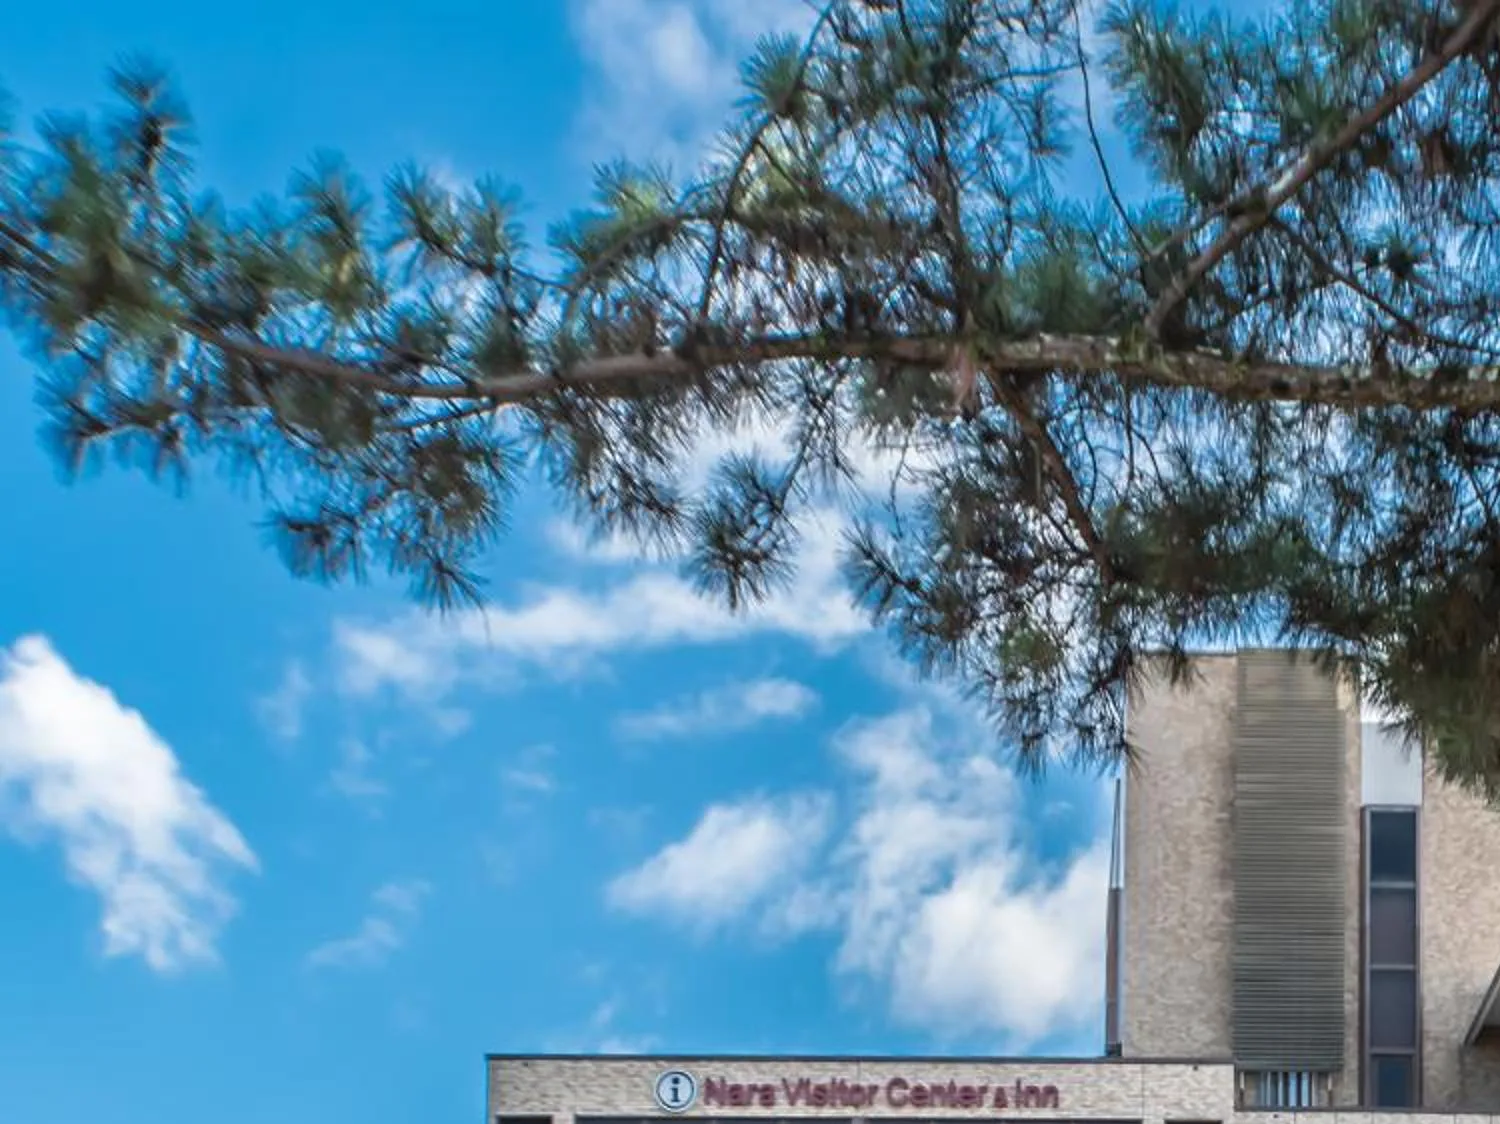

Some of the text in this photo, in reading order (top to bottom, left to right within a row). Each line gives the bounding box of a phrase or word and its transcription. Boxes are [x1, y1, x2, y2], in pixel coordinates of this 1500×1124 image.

[704, 1076, 776, 1107] Nara
[782, 1076, 879, 1108] Visitor
[886, 1076, 988, 1108] Center
[1014, 1076, 1060, 1109] Inn
